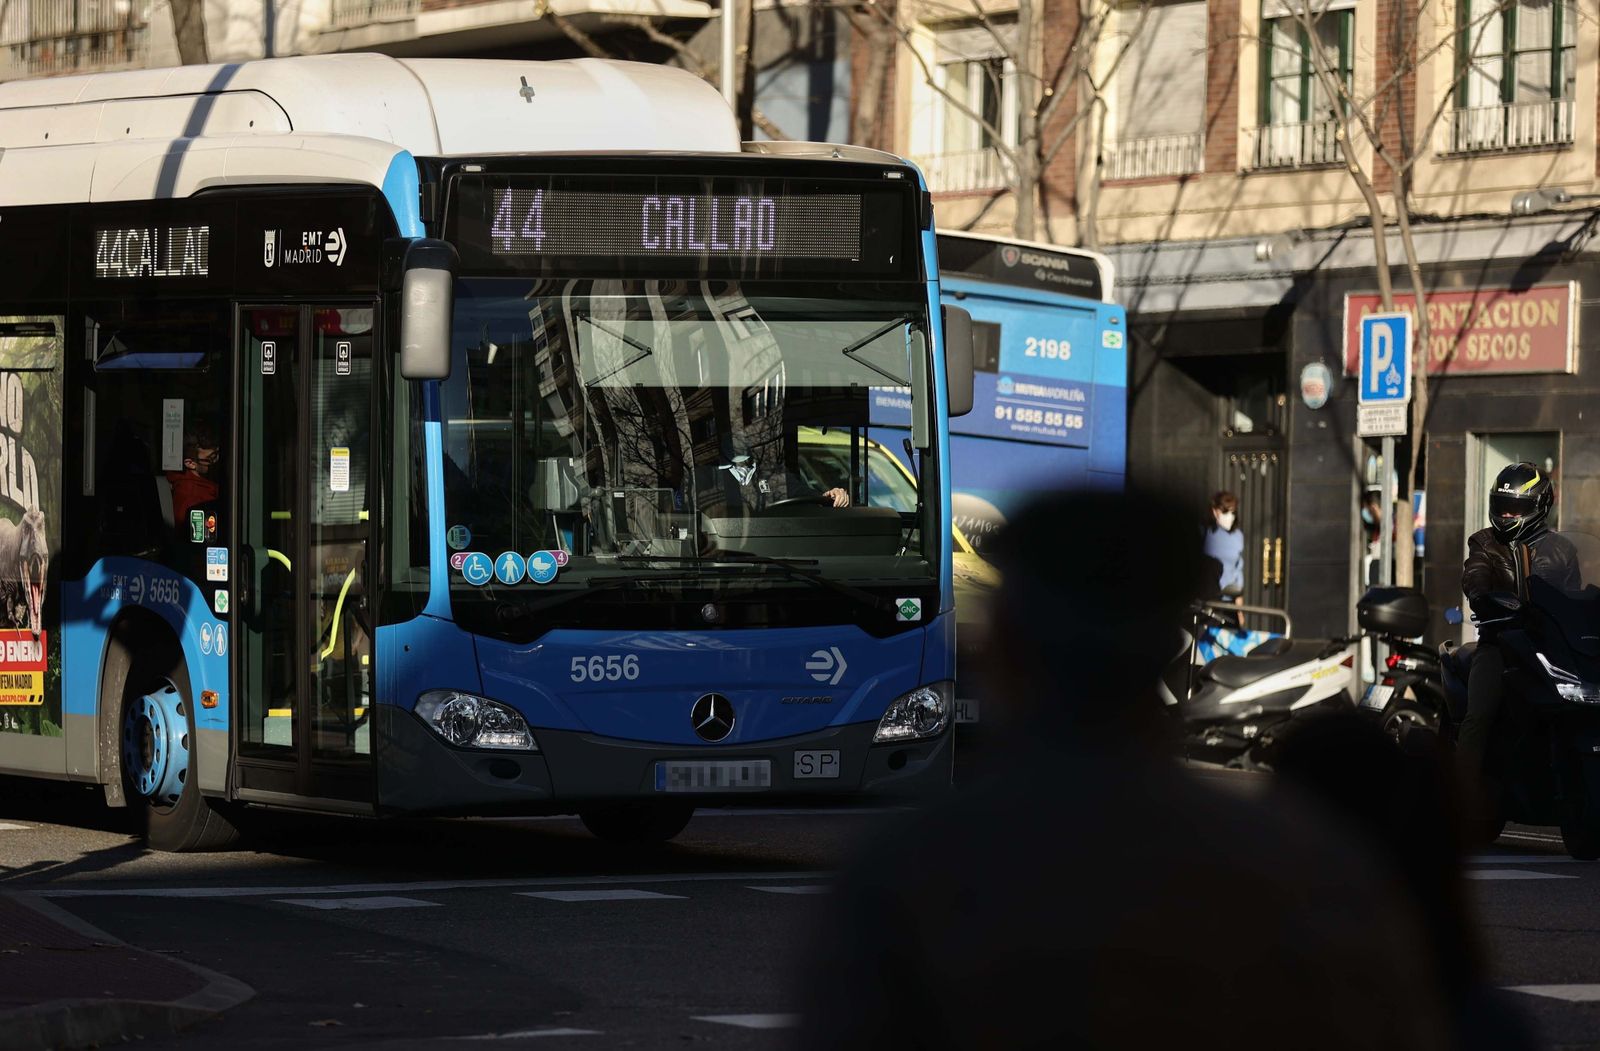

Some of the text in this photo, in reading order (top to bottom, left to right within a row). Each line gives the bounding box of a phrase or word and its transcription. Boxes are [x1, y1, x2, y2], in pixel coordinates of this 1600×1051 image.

[491, 187, 775, 251] 44 CALLAO
[302, 231, 322, 246] EMT
[284, 249, 322, 264] MADRID
[1021, 253, 1070, 271] SCANIA
[1025, 336, 1071, 360] 2198
[1466, 332, 1531, 361] SECOS
[1370, 322, 1393, 393] P
[994, 405, 1083, 430] 91 555 55 55
[454, 555, 462, 565] 2
[557, 552, 565, 563] 4
[112, 575, 128, 586] EMT
[149, 578, 180, 604] 5656
[900, 606, 916, 614] GNC
[6, 640, 43, 662] ENERO
[570, 653, 640, 683] 5656
[15, 674, 33, 690] MADRID
